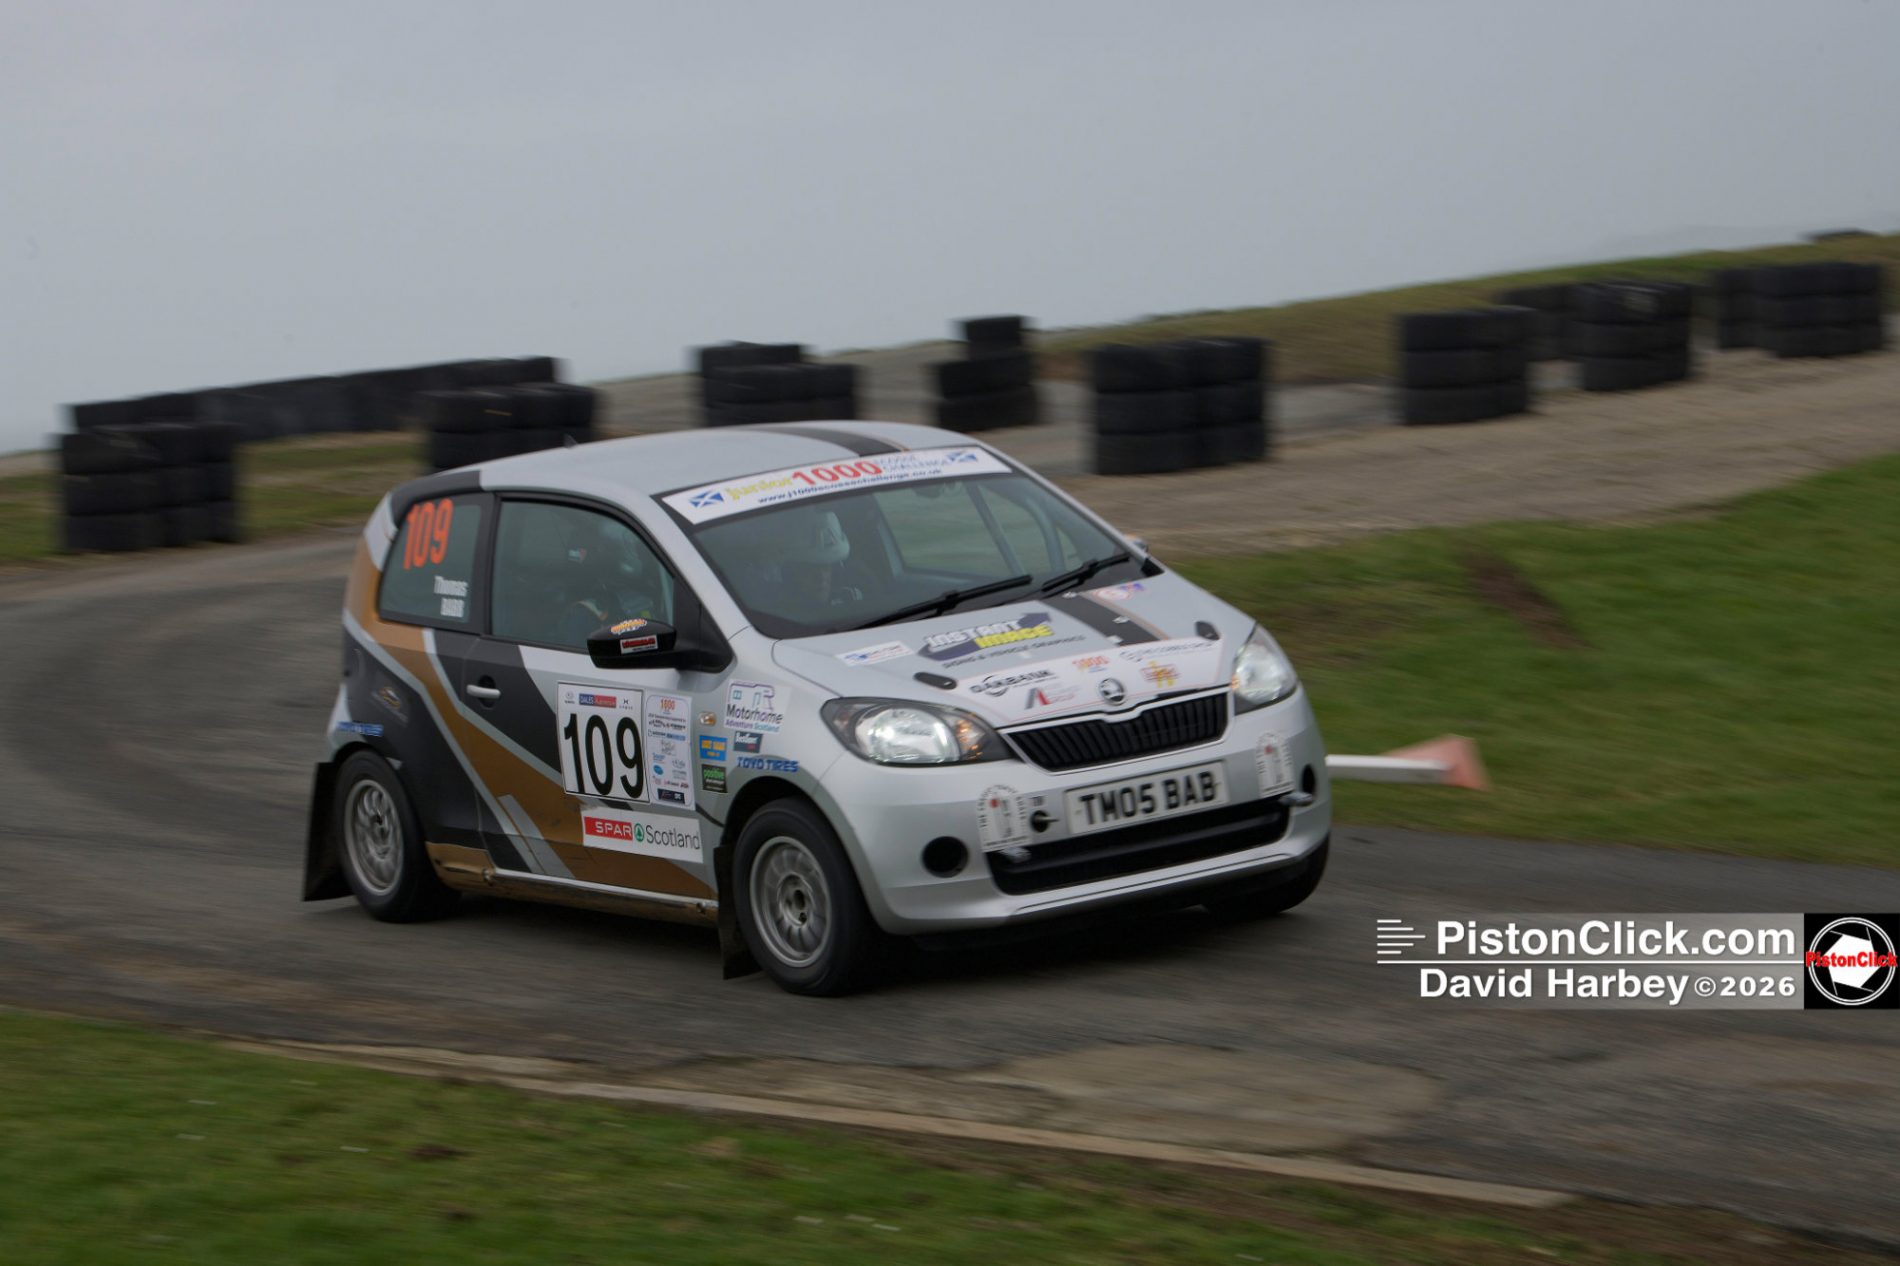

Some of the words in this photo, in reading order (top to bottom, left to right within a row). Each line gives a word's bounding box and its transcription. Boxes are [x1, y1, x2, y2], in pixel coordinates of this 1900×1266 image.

[792, 459, 883, 486] 1000
[403, 498, 454, 570] 109
[973, 623, 1055, 649] IMAGE
[726, 703, 783, 725] Motorhome
[564, 713, 644, 799] 109
[737, 756, 765, 770] TOYO
[766, 758, 799, 773] TIRES
[1079, 783, 1157, 825] TM05
[1162, 771, 1216, 810] BAB
[594, 821, 632, 837] SPAR
[645, 825, 701, 850] Scotland
